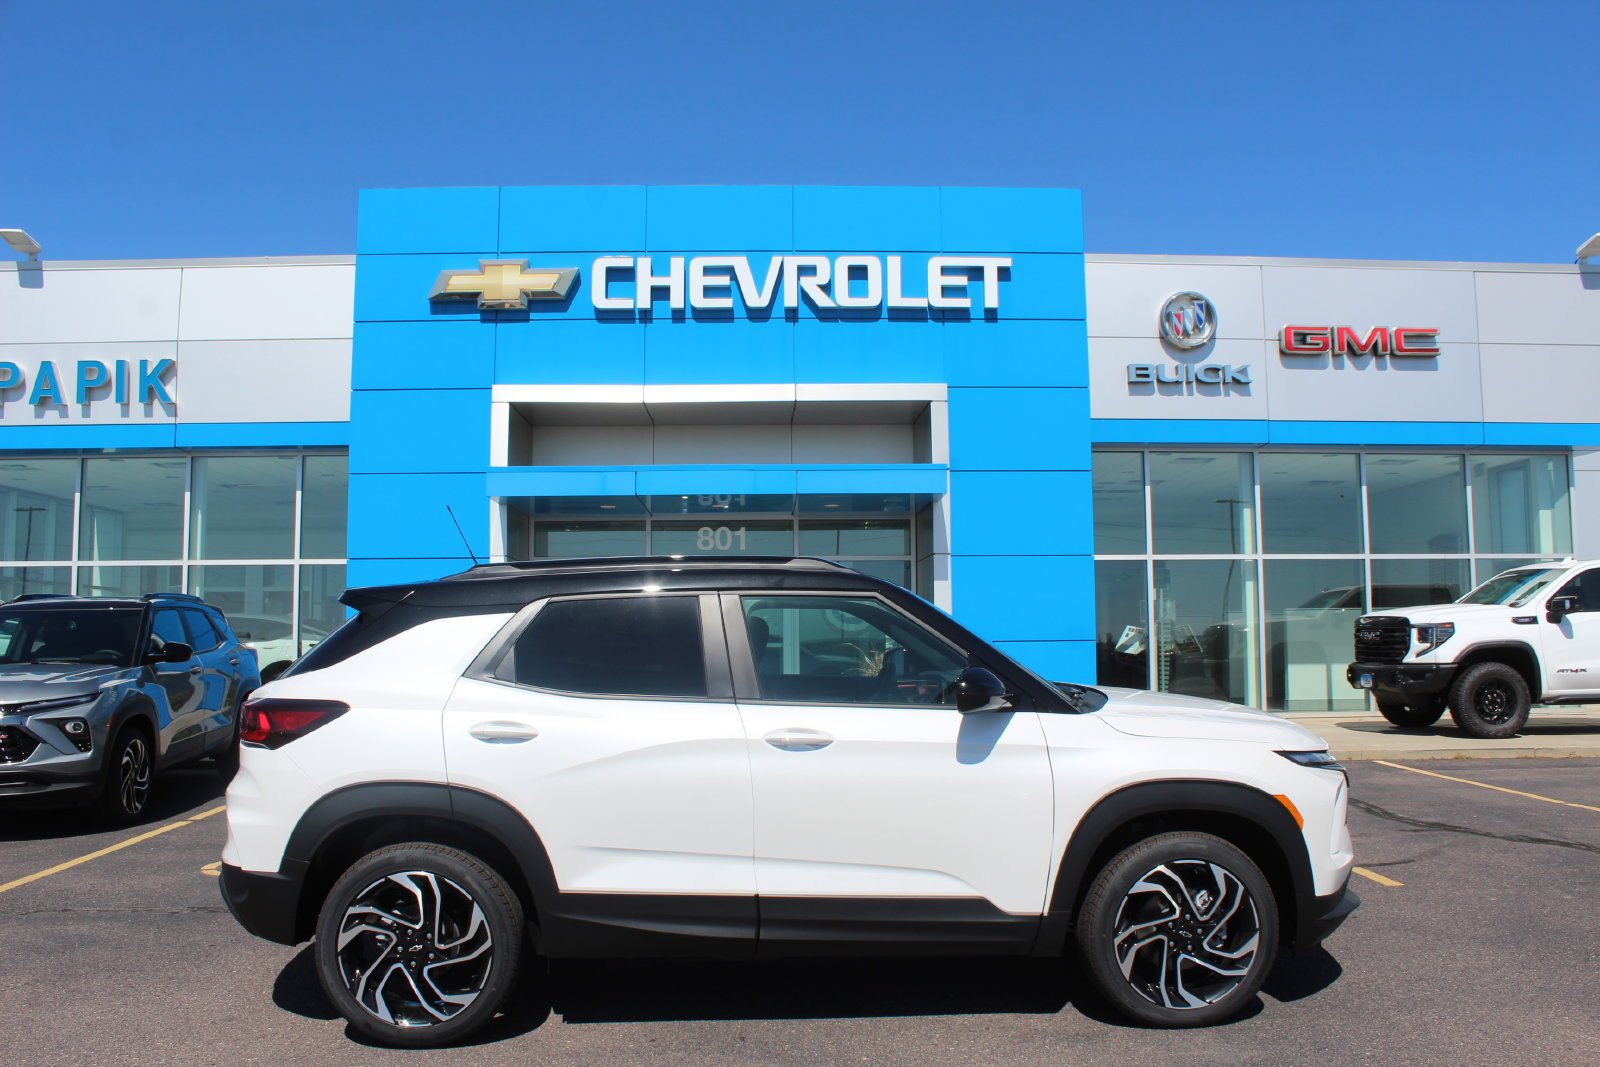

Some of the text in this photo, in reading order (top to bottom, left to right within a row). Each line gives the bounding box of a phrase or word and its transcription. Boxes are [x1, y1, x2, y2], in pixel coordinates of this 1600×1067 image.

[591, 255, 1012, 309] CHEVROLET
[1279, 324, 1441, 357] GMC
[0, 359, 176, 405] PAPIK
[1126, 363, 1252, 384] BUICK
[696, 526, 746, 551] 801
